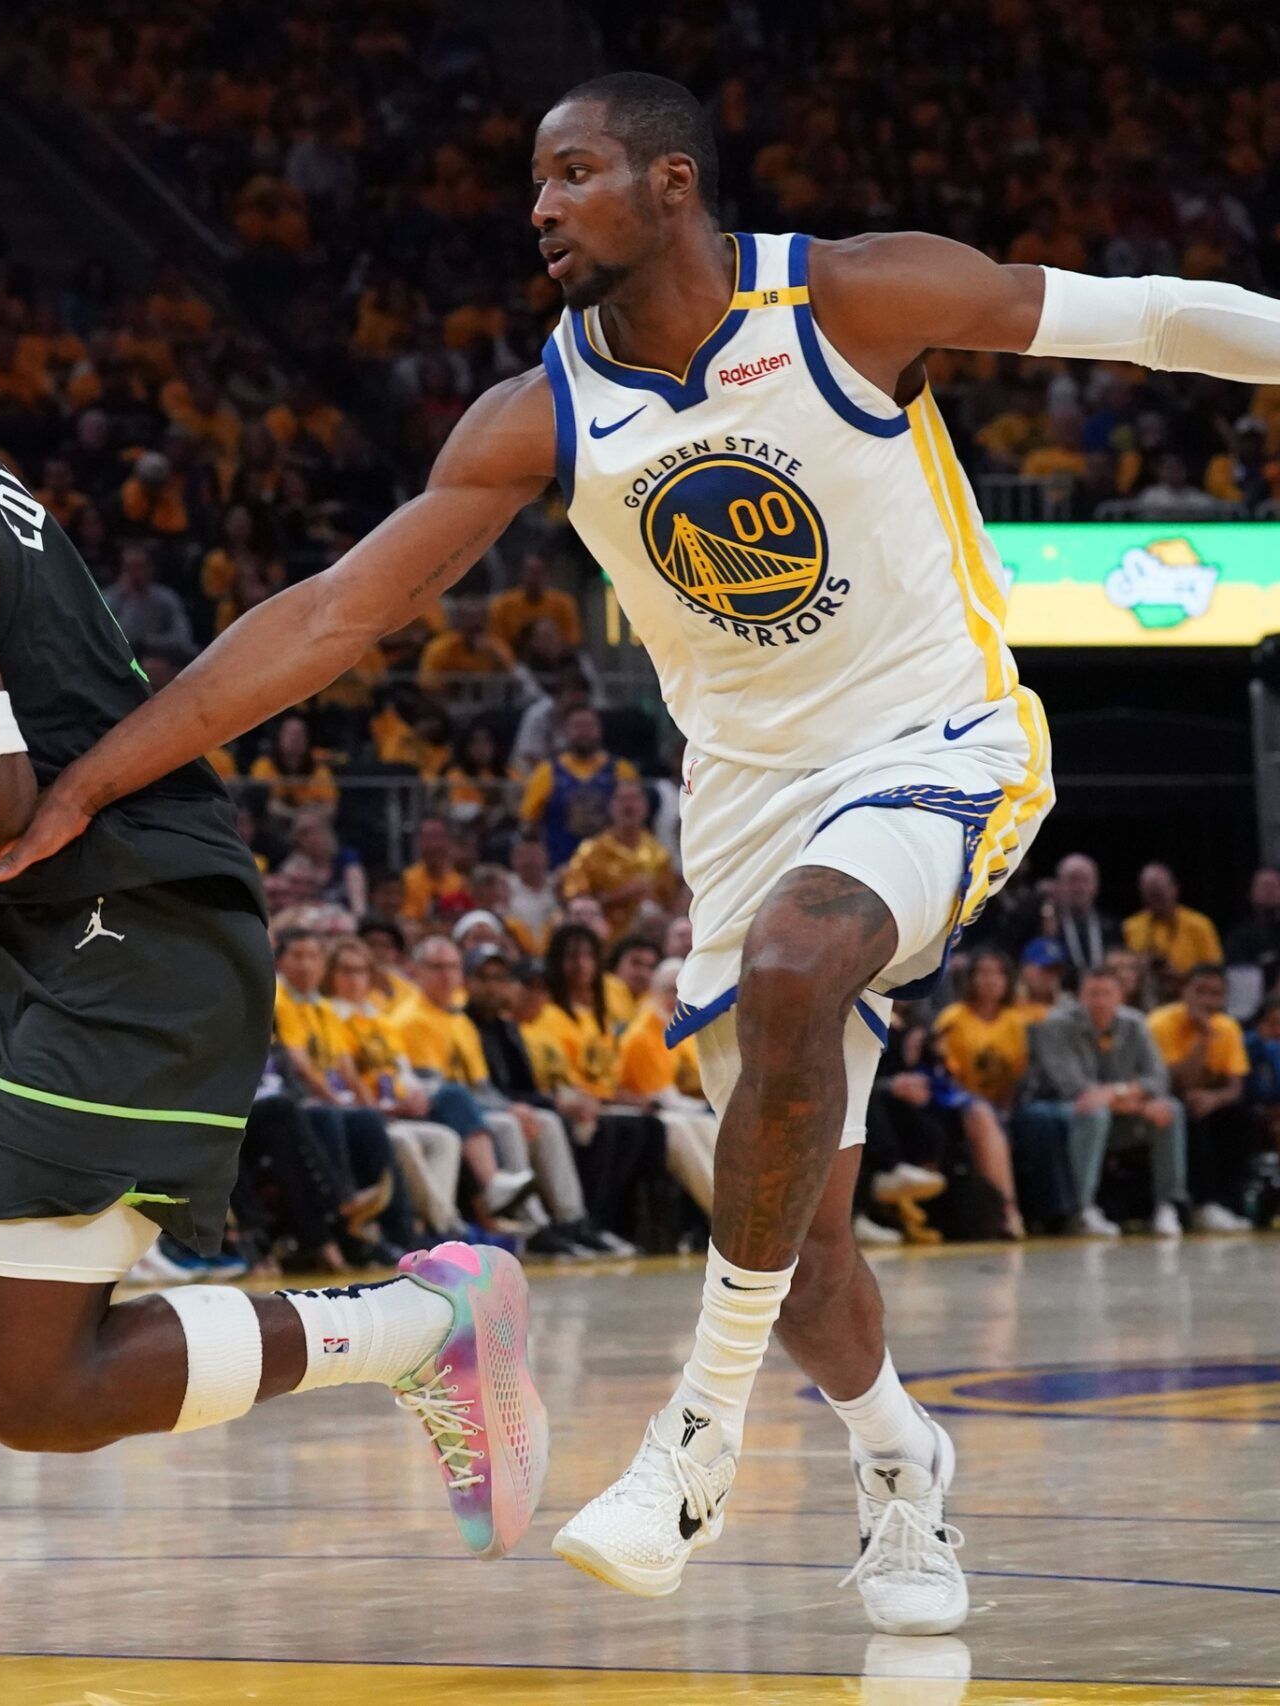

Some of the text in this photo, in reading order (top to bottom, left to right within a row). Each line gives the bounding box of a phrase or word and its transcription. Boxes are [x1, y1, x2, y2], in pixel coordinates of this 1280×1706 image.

[762, 291, 779, 305] 16
[718, 353, 791, 386] Rakuten
[624, 436, 803, 509] GOLDEN STATE
[728, 491, 796, 543] 00
